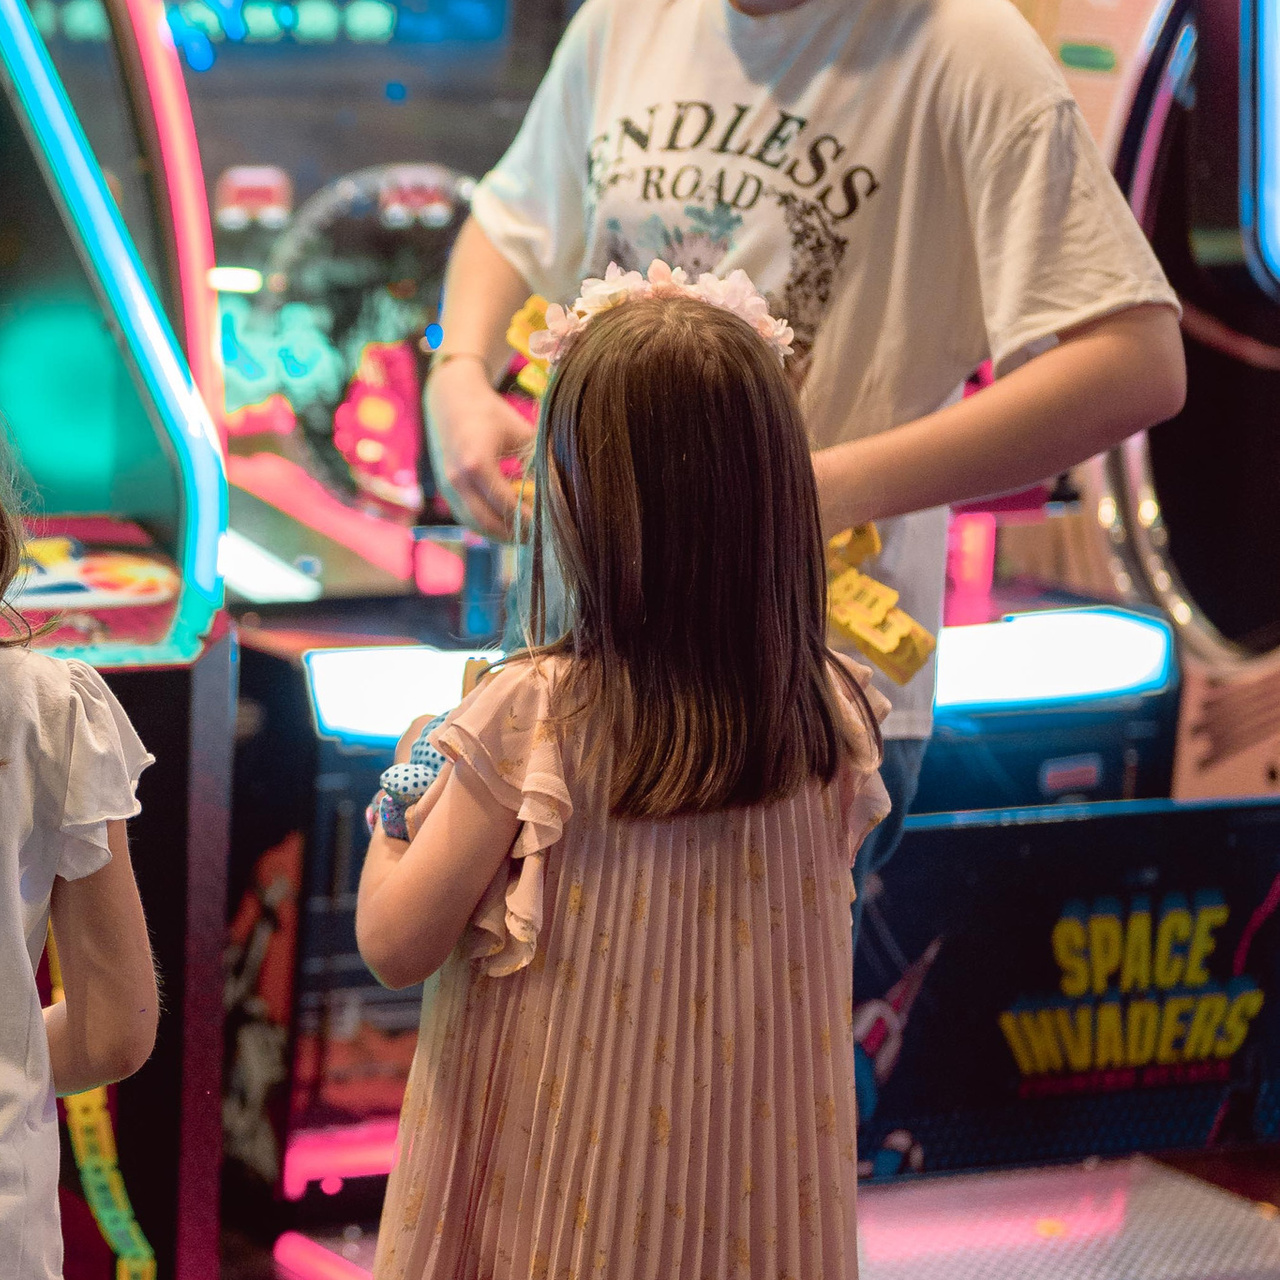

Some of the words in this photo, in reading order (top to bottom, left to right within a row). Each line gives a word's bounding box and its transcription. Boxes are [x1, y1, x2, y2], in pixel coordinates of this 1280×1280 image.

[640, 163, 764, 212] ROAD
[1051, 902, 1231, 999] SPACE
[998, 988, 1266, 1076] INVADERS
